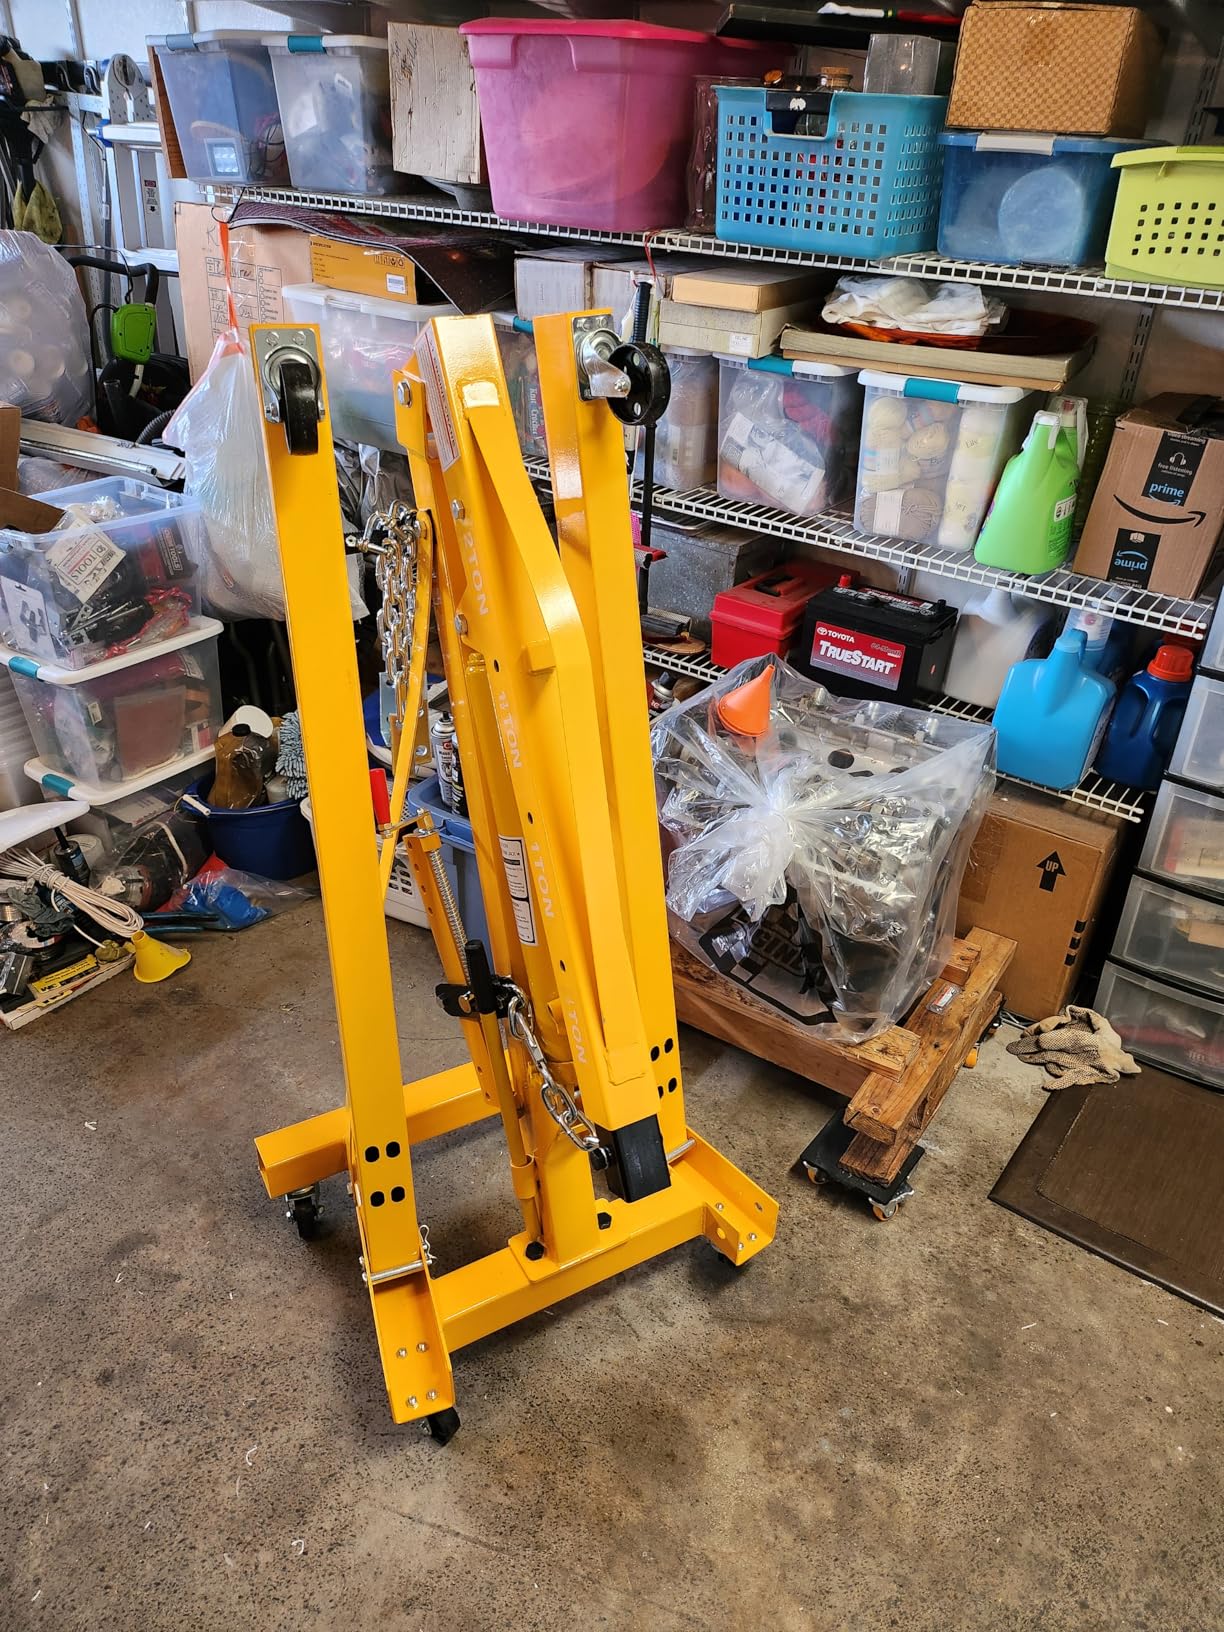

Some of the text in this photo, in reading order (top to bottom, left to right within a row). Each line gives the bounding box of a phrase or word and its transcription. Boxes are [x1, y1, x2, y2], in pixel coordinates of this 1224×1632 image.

[1169, 465, 1193, 475] listening
[1149, 483, 1184, 497] prime
[71, 554, 98, 581] TOOLS
[1114, 558, 1148, 571] prime
[827, 628, 855, 643] TOYOTA
[1045, 860, 1059, 873] UP
